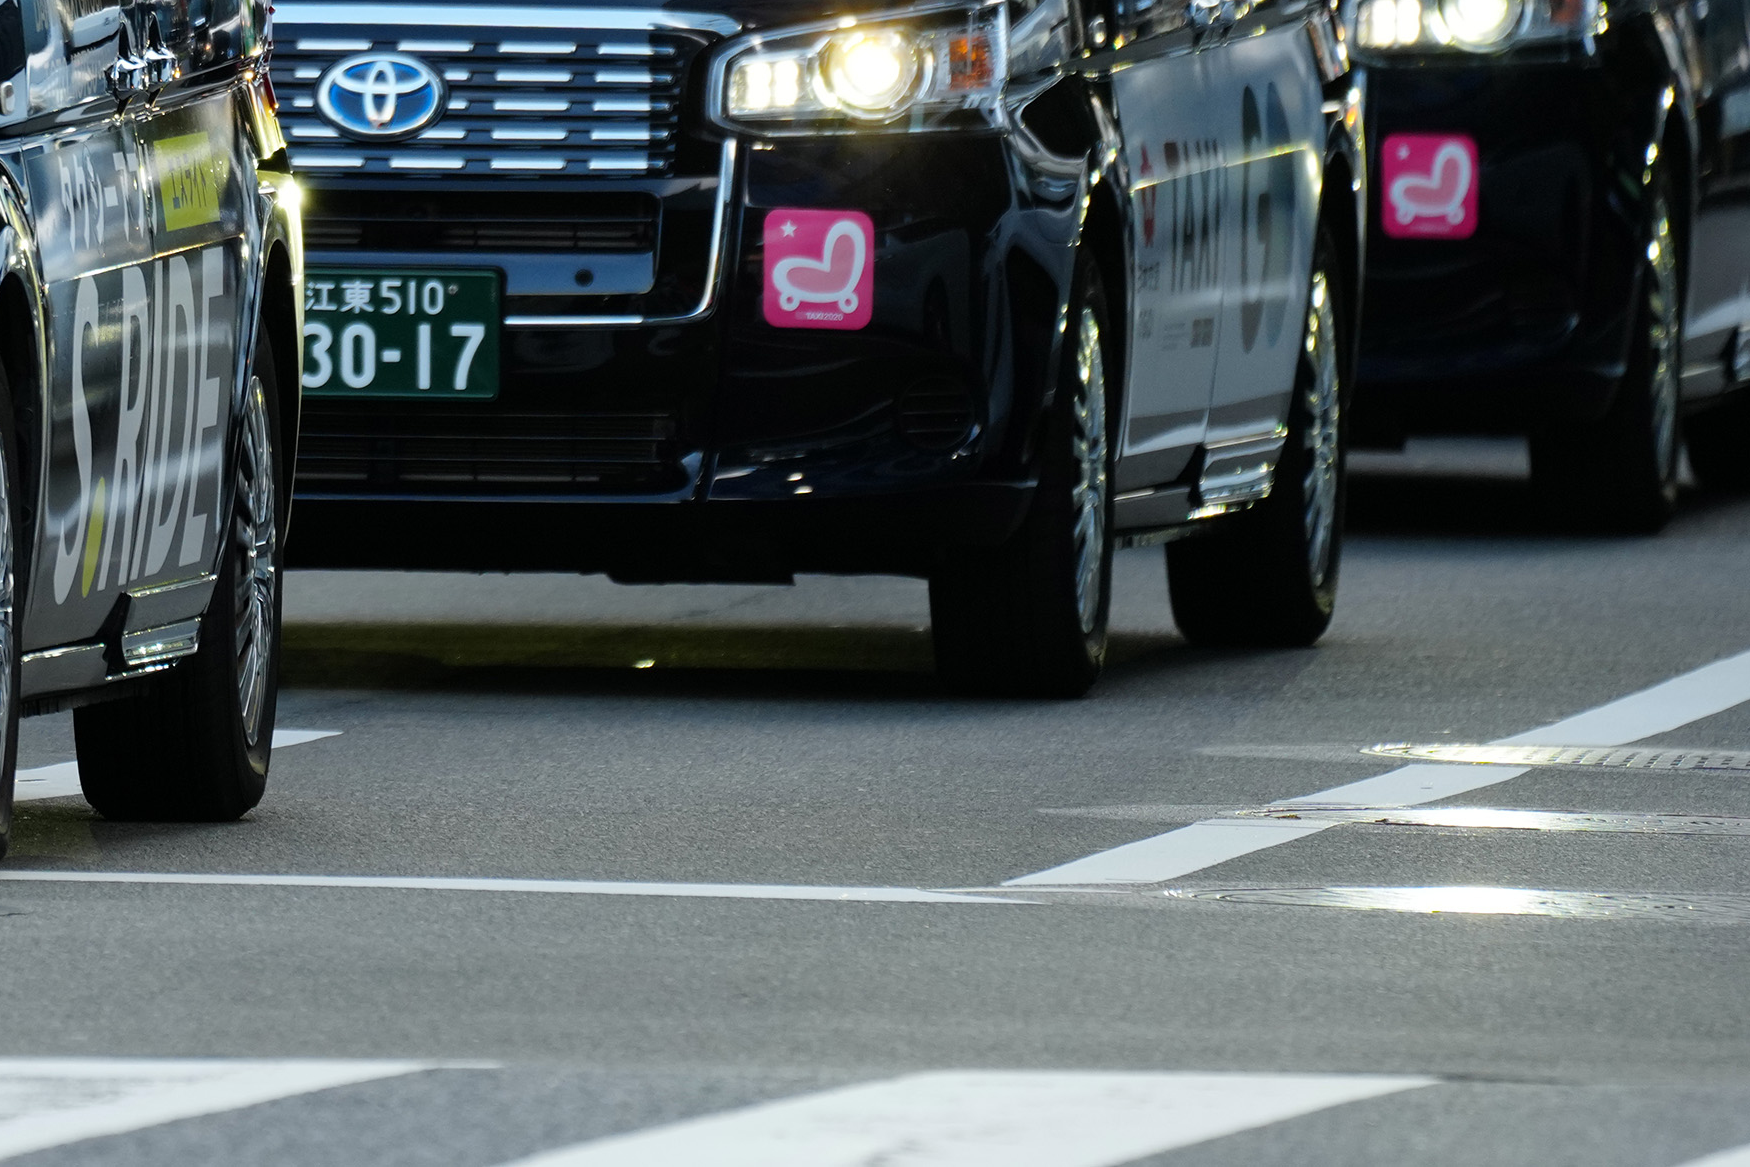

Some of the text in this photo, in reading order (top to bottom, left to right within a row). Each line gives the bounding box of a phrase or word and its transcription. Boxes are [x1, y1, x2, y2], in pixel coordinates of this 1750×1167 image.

[304, 278, 445, 315] 江東 510
[301, 322, 486, 391] 30-17
[53, 247, 226, 606] S.RIDE
